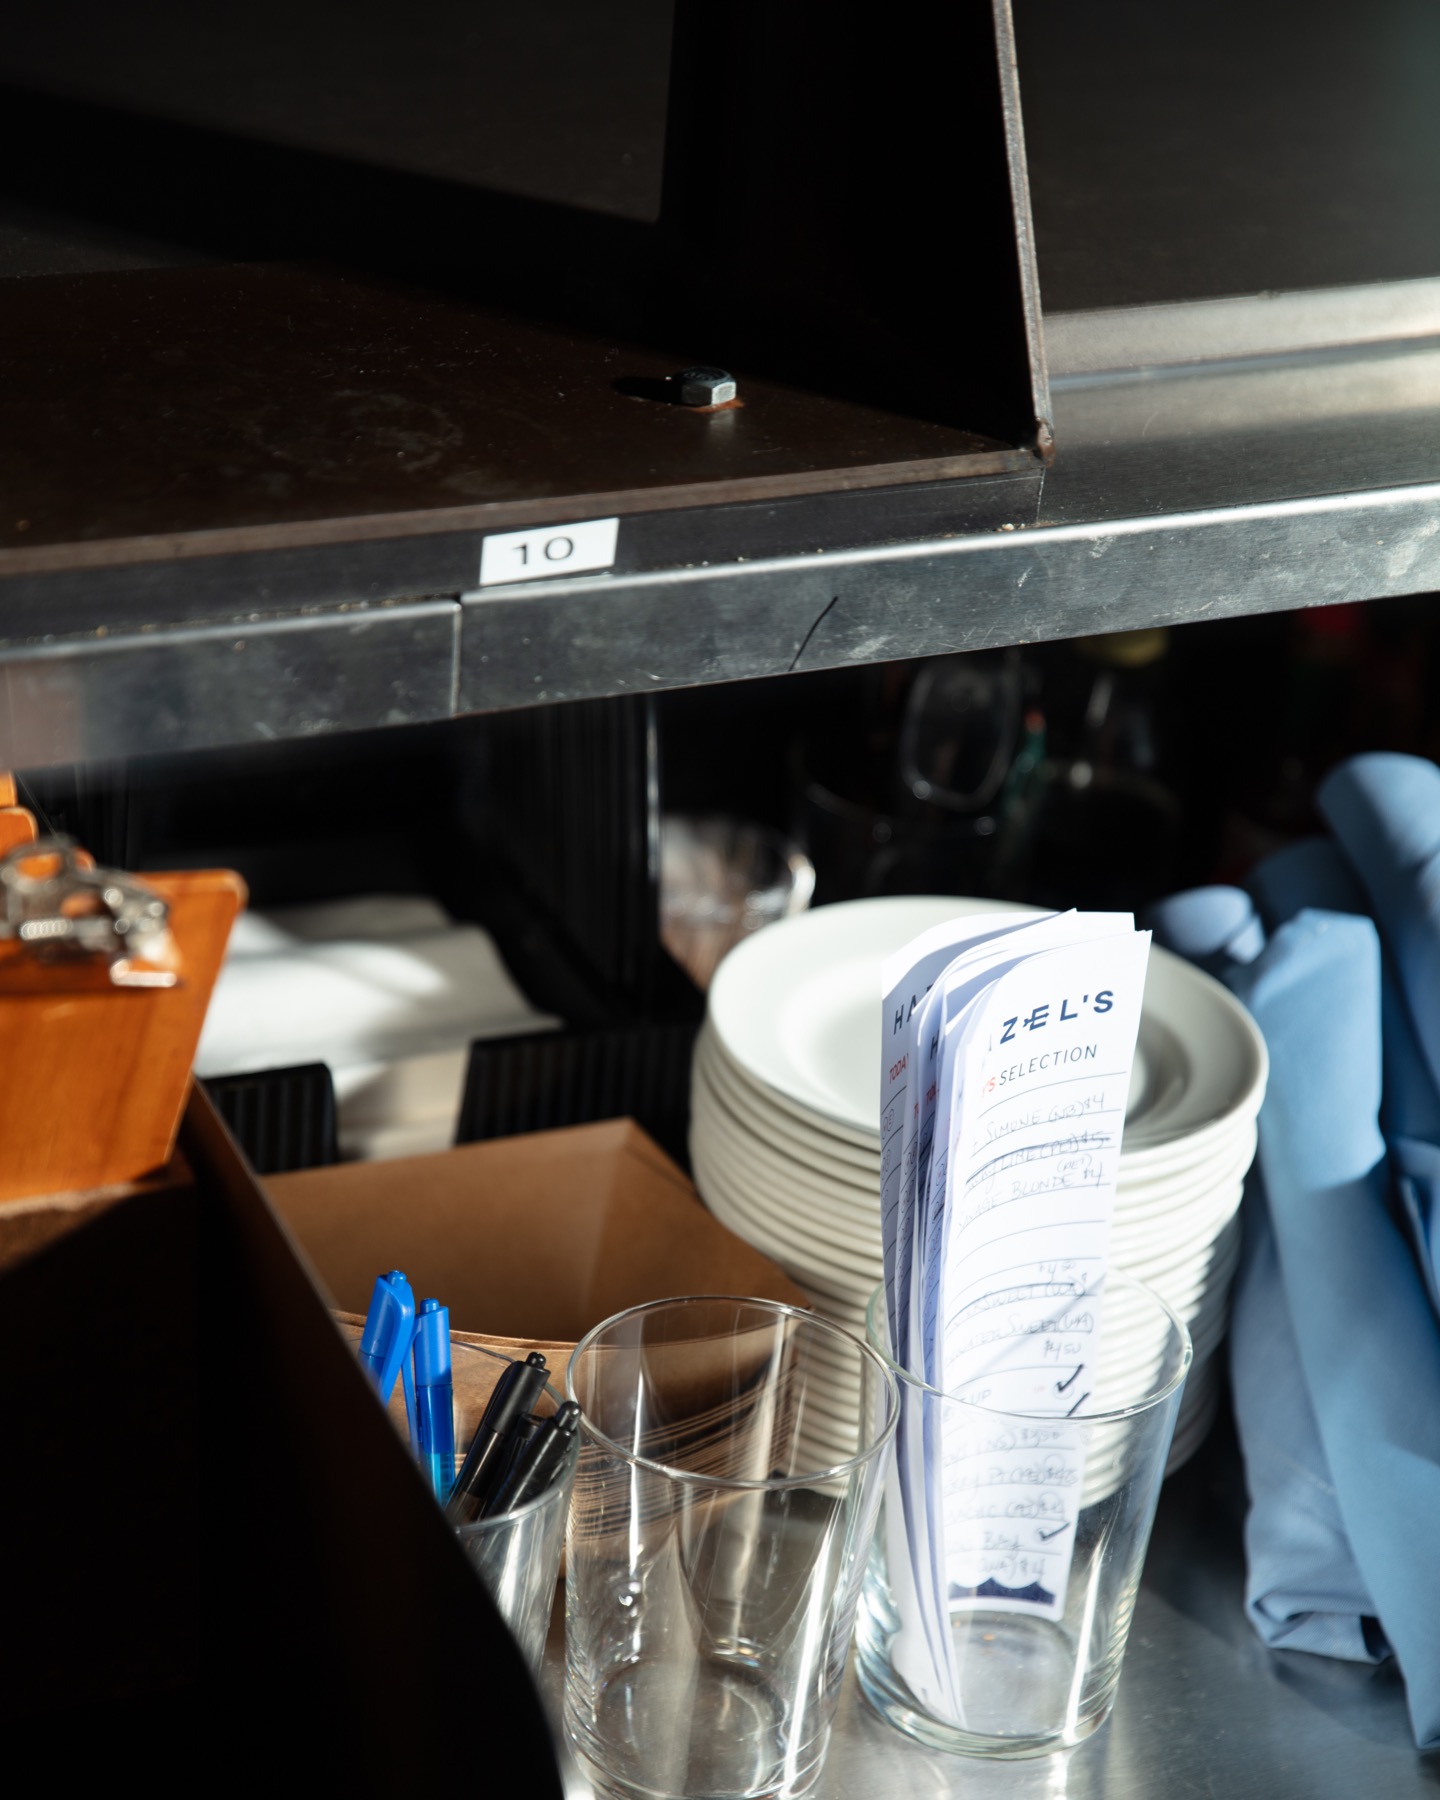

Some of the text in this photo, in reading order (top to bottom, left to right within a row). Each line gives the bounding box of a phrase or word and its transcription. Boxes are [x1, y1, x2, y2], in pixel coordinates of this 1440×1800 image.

[513, 536, 574, 565] 10
[987, 990, 1114, 1052] ZEL'S
[999, 1044, 1097, 1086] SELECTION
